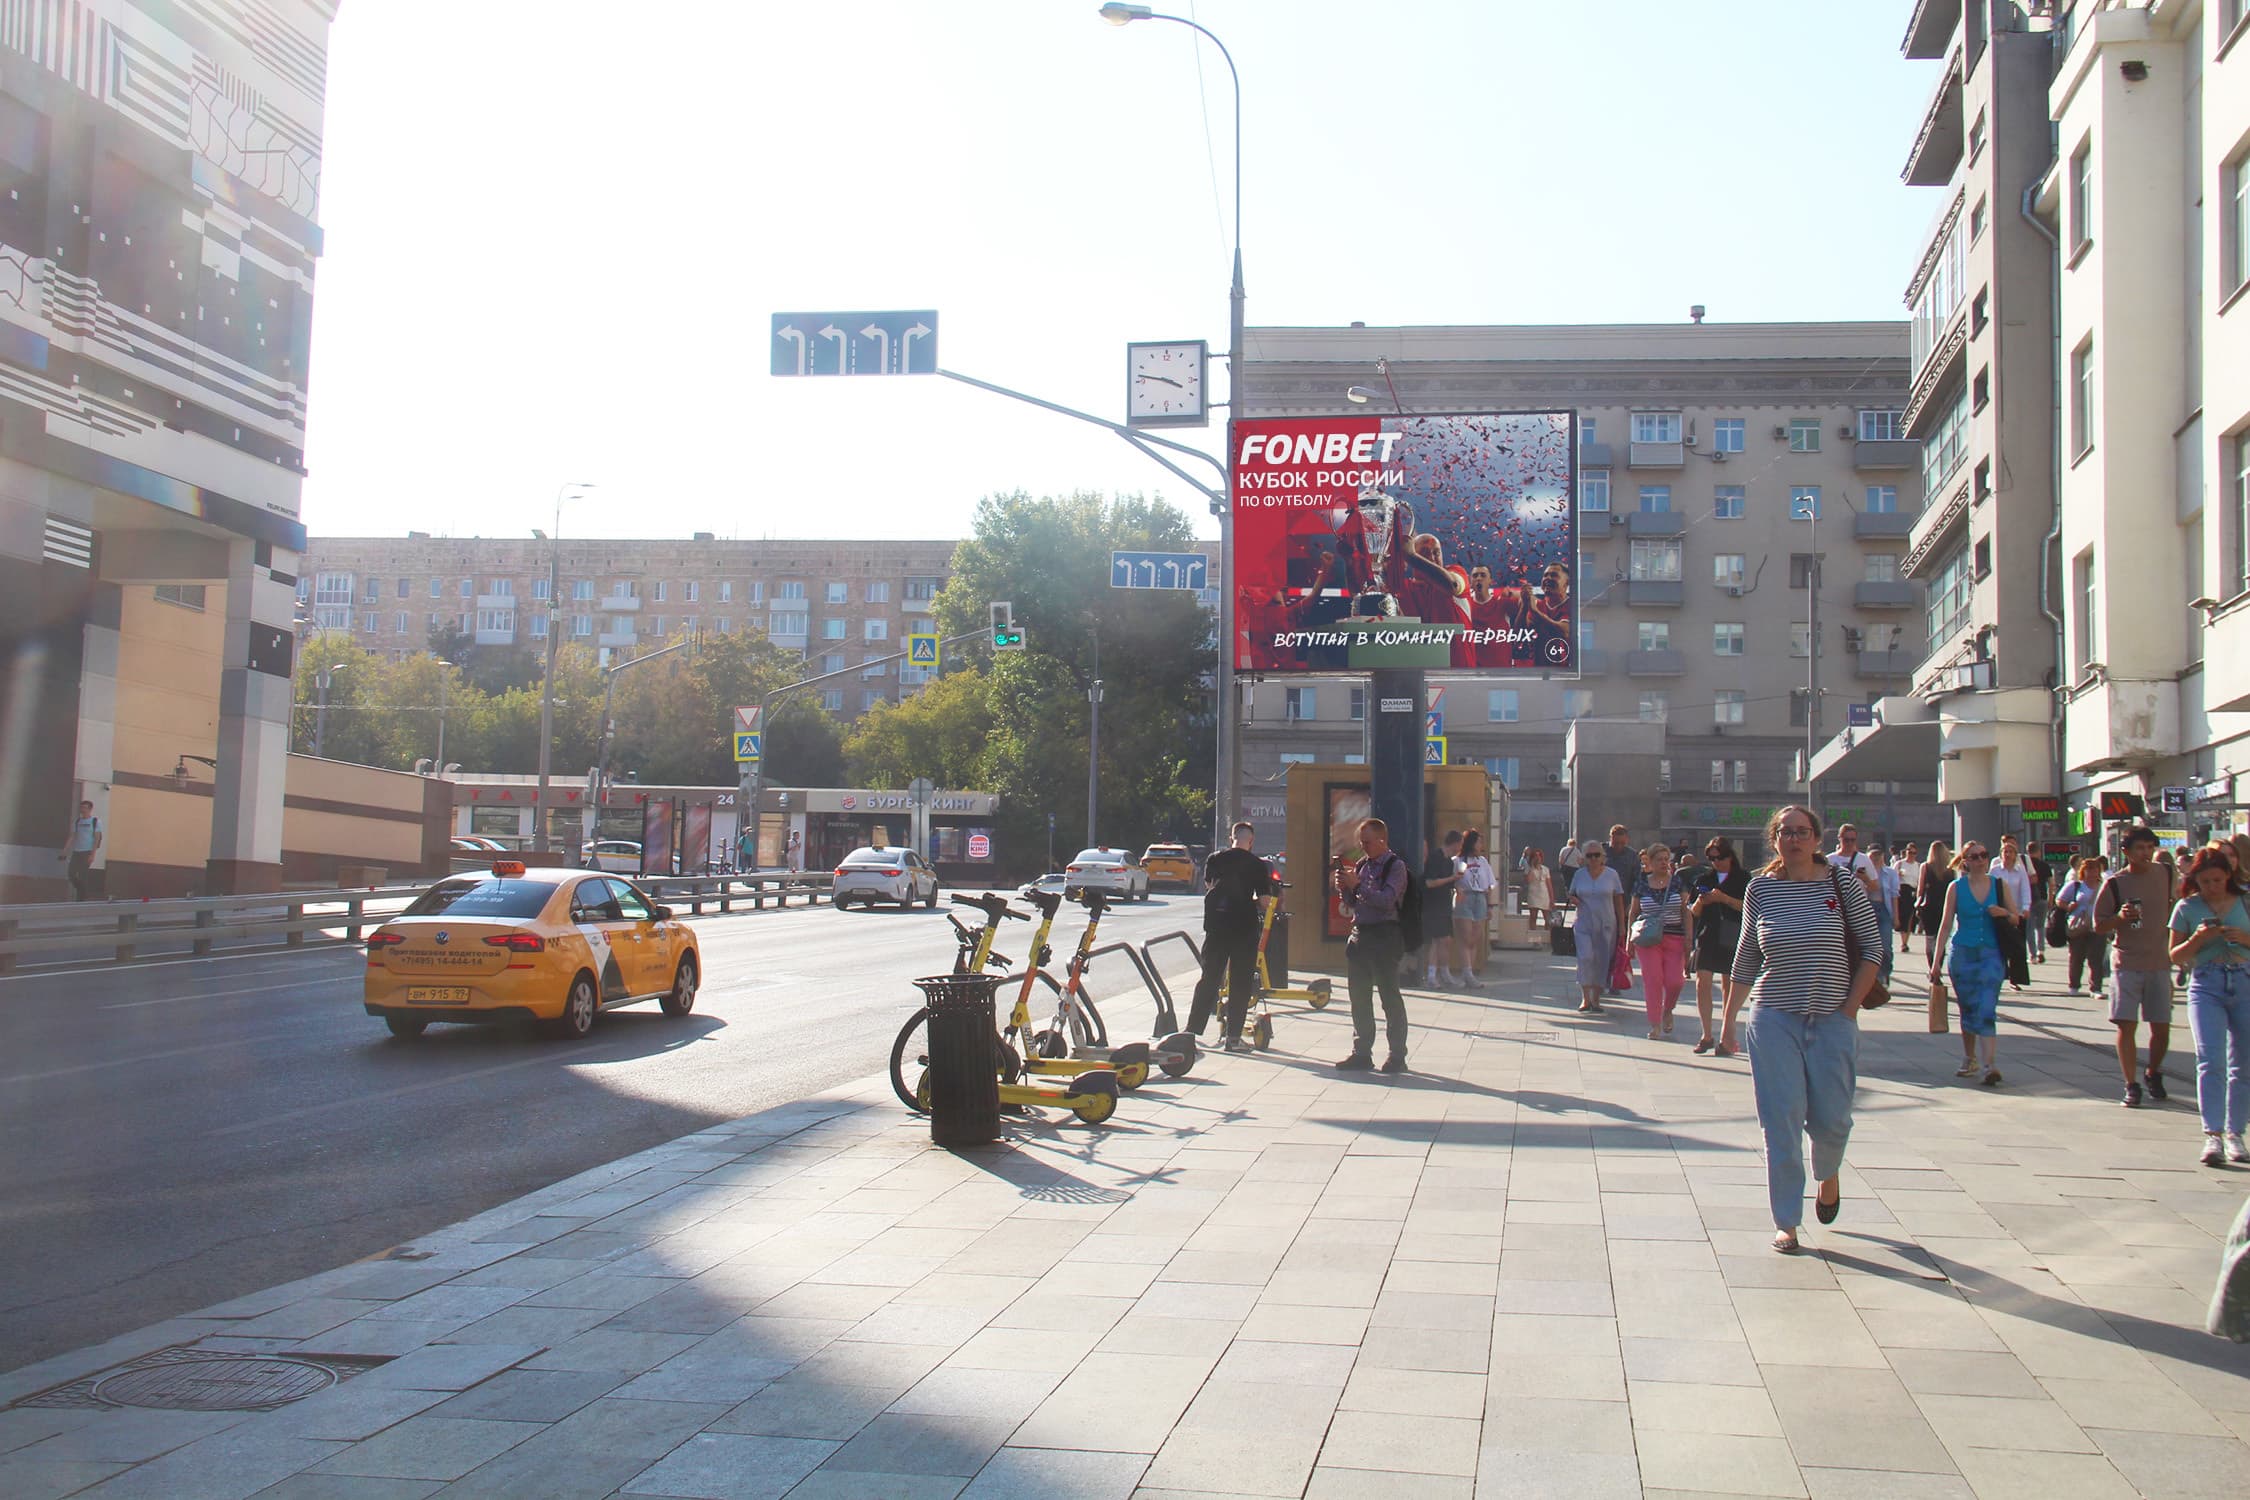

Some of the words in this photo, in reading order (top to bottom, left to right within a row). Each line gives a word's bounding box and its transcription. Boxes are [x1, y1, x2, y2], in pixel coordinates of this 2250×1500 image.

[1240, 433, 1402, 465] FONBET
[1240, 472, 1308, 489] КУБОК
[1316, 470, 1404, 487] РОССИИ
[1240, 496, 1260, 507] ПО
[1263, 494, 1332, 507] ФУТБОЛУ
[1274, 631, 1350, 648] ВСТУПАЙ
[1356, 632, 1369, 646] В
[1374, 629, 1454, 645] КОМАНДУ
[1462, 628, 1535, 644] ПЕРВЫХ
[1549, 645, 1565, 656] 6+
[717, 794, 735, 805] 24
[866, 796, 925, 809] БУРГЕ
[931, 798, 975, 810] КИНГ
[2170, 796, 2181, 804] 24
[1250, 807, 1270, 817] CITY
[2022, 811, 2059, 820] НАПИТКИ
[431, 989, 449, 999] 915
